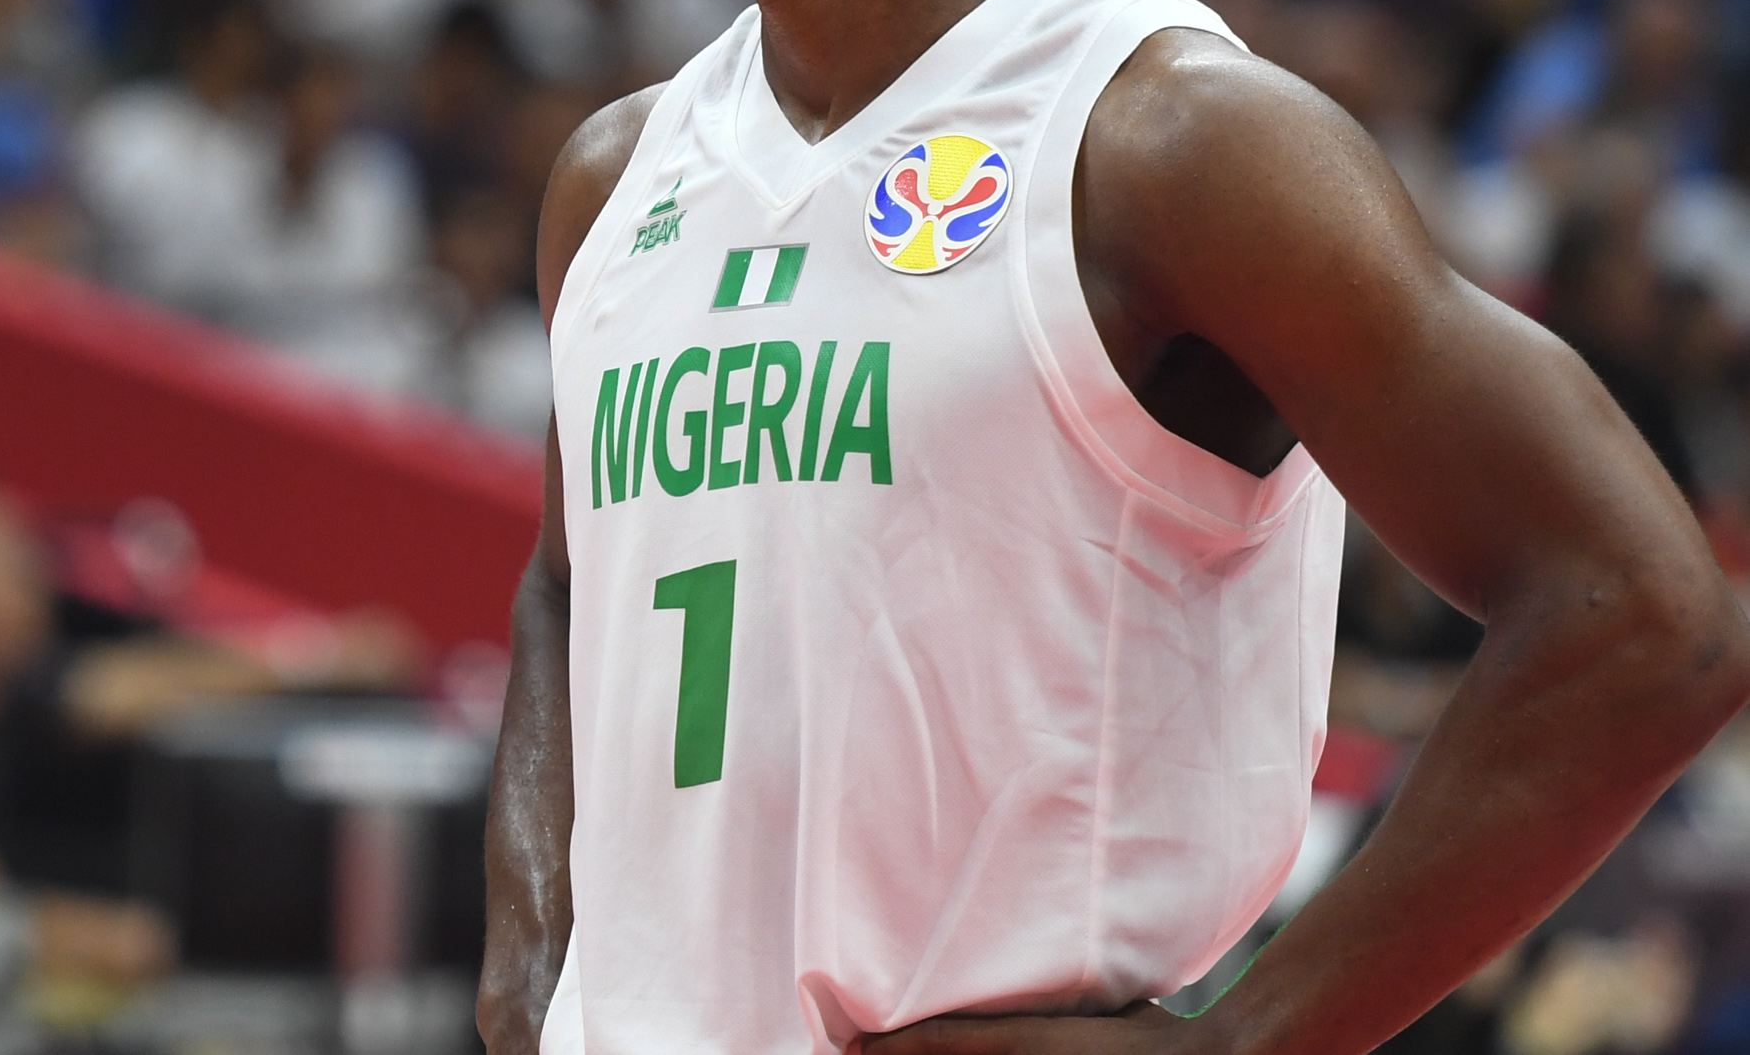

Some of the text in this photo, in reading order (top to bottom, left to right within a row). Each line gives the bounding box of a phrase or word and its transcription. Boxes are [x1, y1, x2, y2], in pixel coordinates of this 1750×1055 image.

[629, 210, 687, 257] PEAK
[591, 340, 893, 510] NIGERIA
[652, 558, 738, 790] 1
